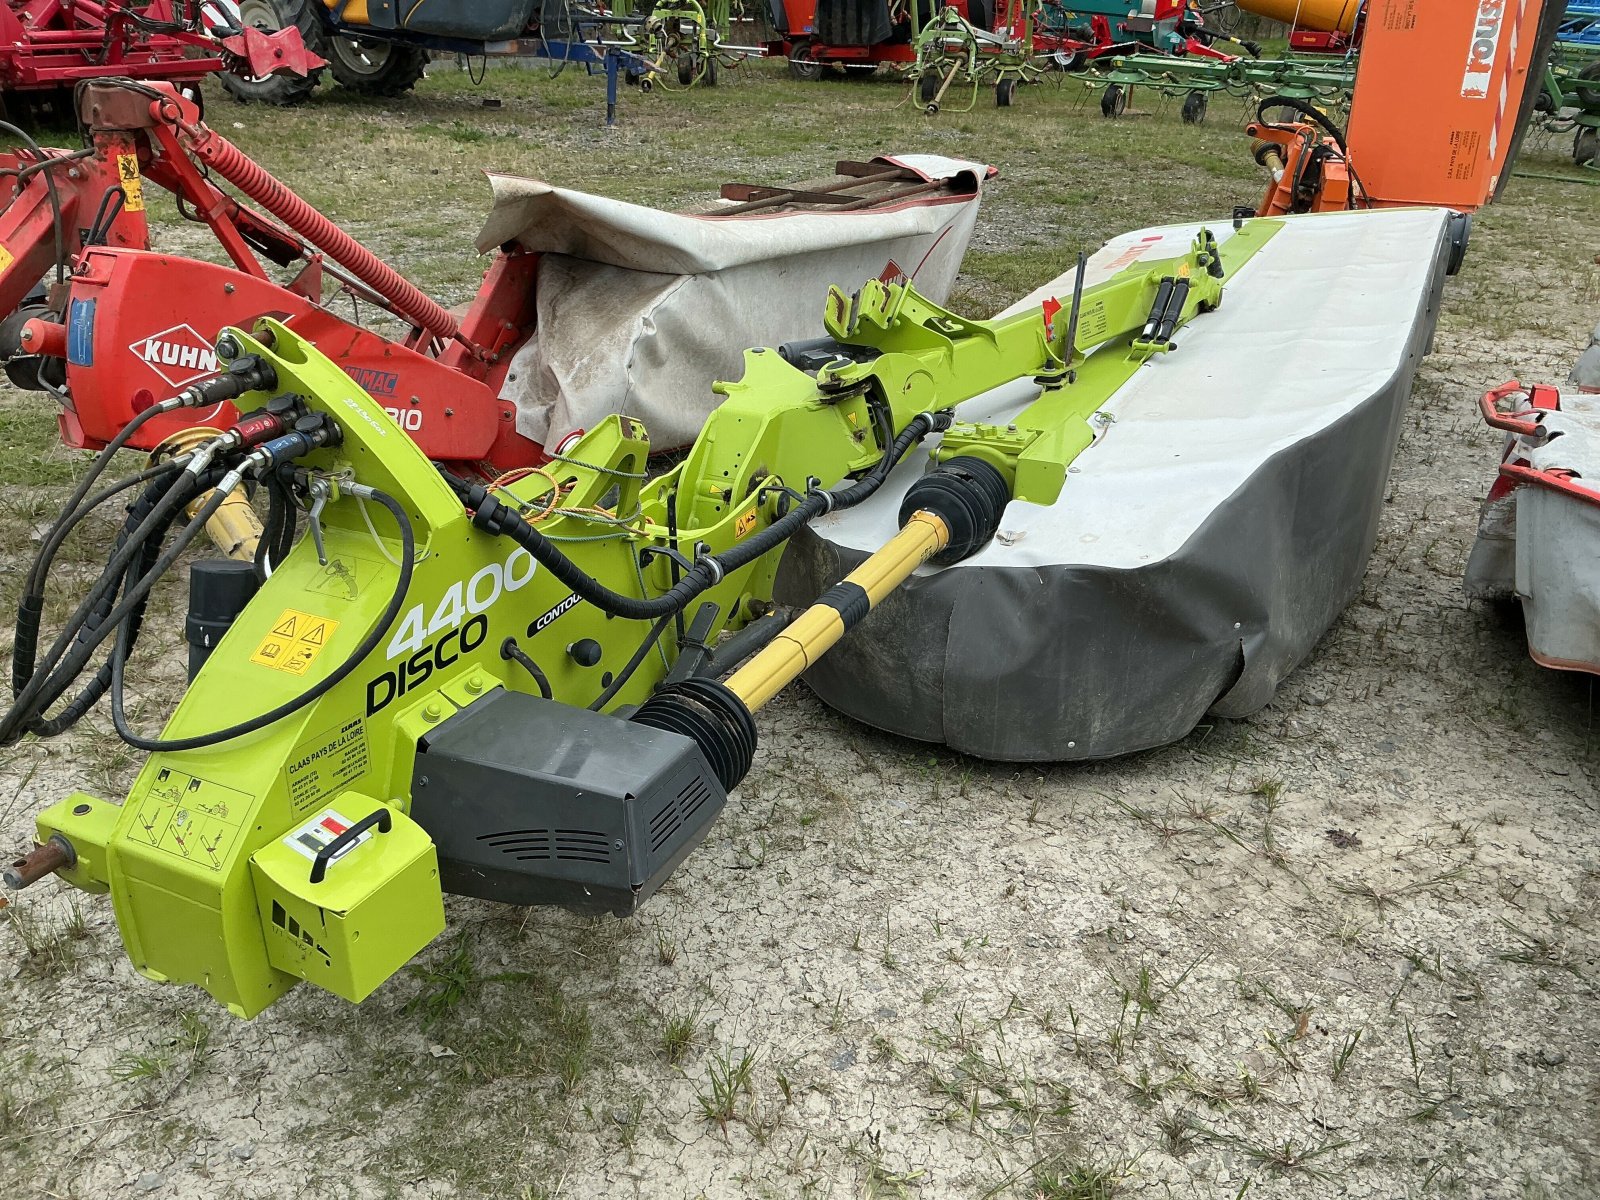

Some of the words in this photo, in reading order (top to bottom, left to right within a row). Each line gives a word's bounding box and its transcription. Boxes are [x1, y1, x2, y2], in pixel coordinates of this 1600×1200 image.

[144, 339, 217, 372] KUHN
[387, 545, 538, 661] 4400
[536, 593, 583, 630] CONTOU
[366, 613, 488, 718] DISCO
[290, 757, 310, 774] CLAAS
[311, 747, 327, 761] PAYS
[329, 741, 337, 751] DE
[338, 737, 346, 746] LA
[347, 726, 363, 740] LOIRE
